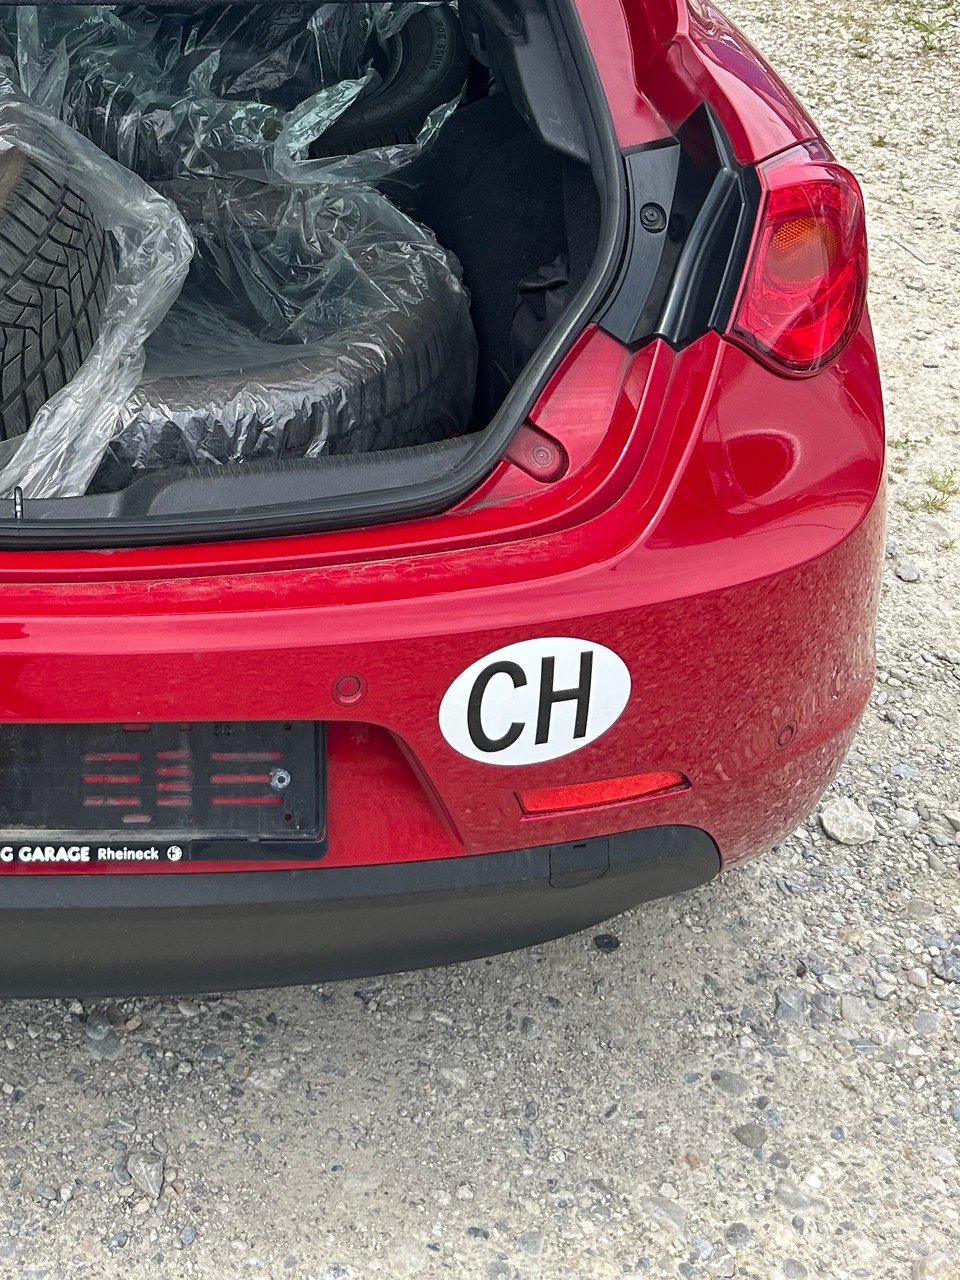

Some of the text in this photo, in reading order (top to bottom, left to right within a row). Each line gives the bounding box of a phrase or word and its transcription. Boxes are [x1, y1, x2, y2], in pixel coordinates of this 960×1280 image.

[467, 650, 593, 753] CH
[18, 846, 91, 862] GARAGE
[97, 846, 159, 860] Rheineck
